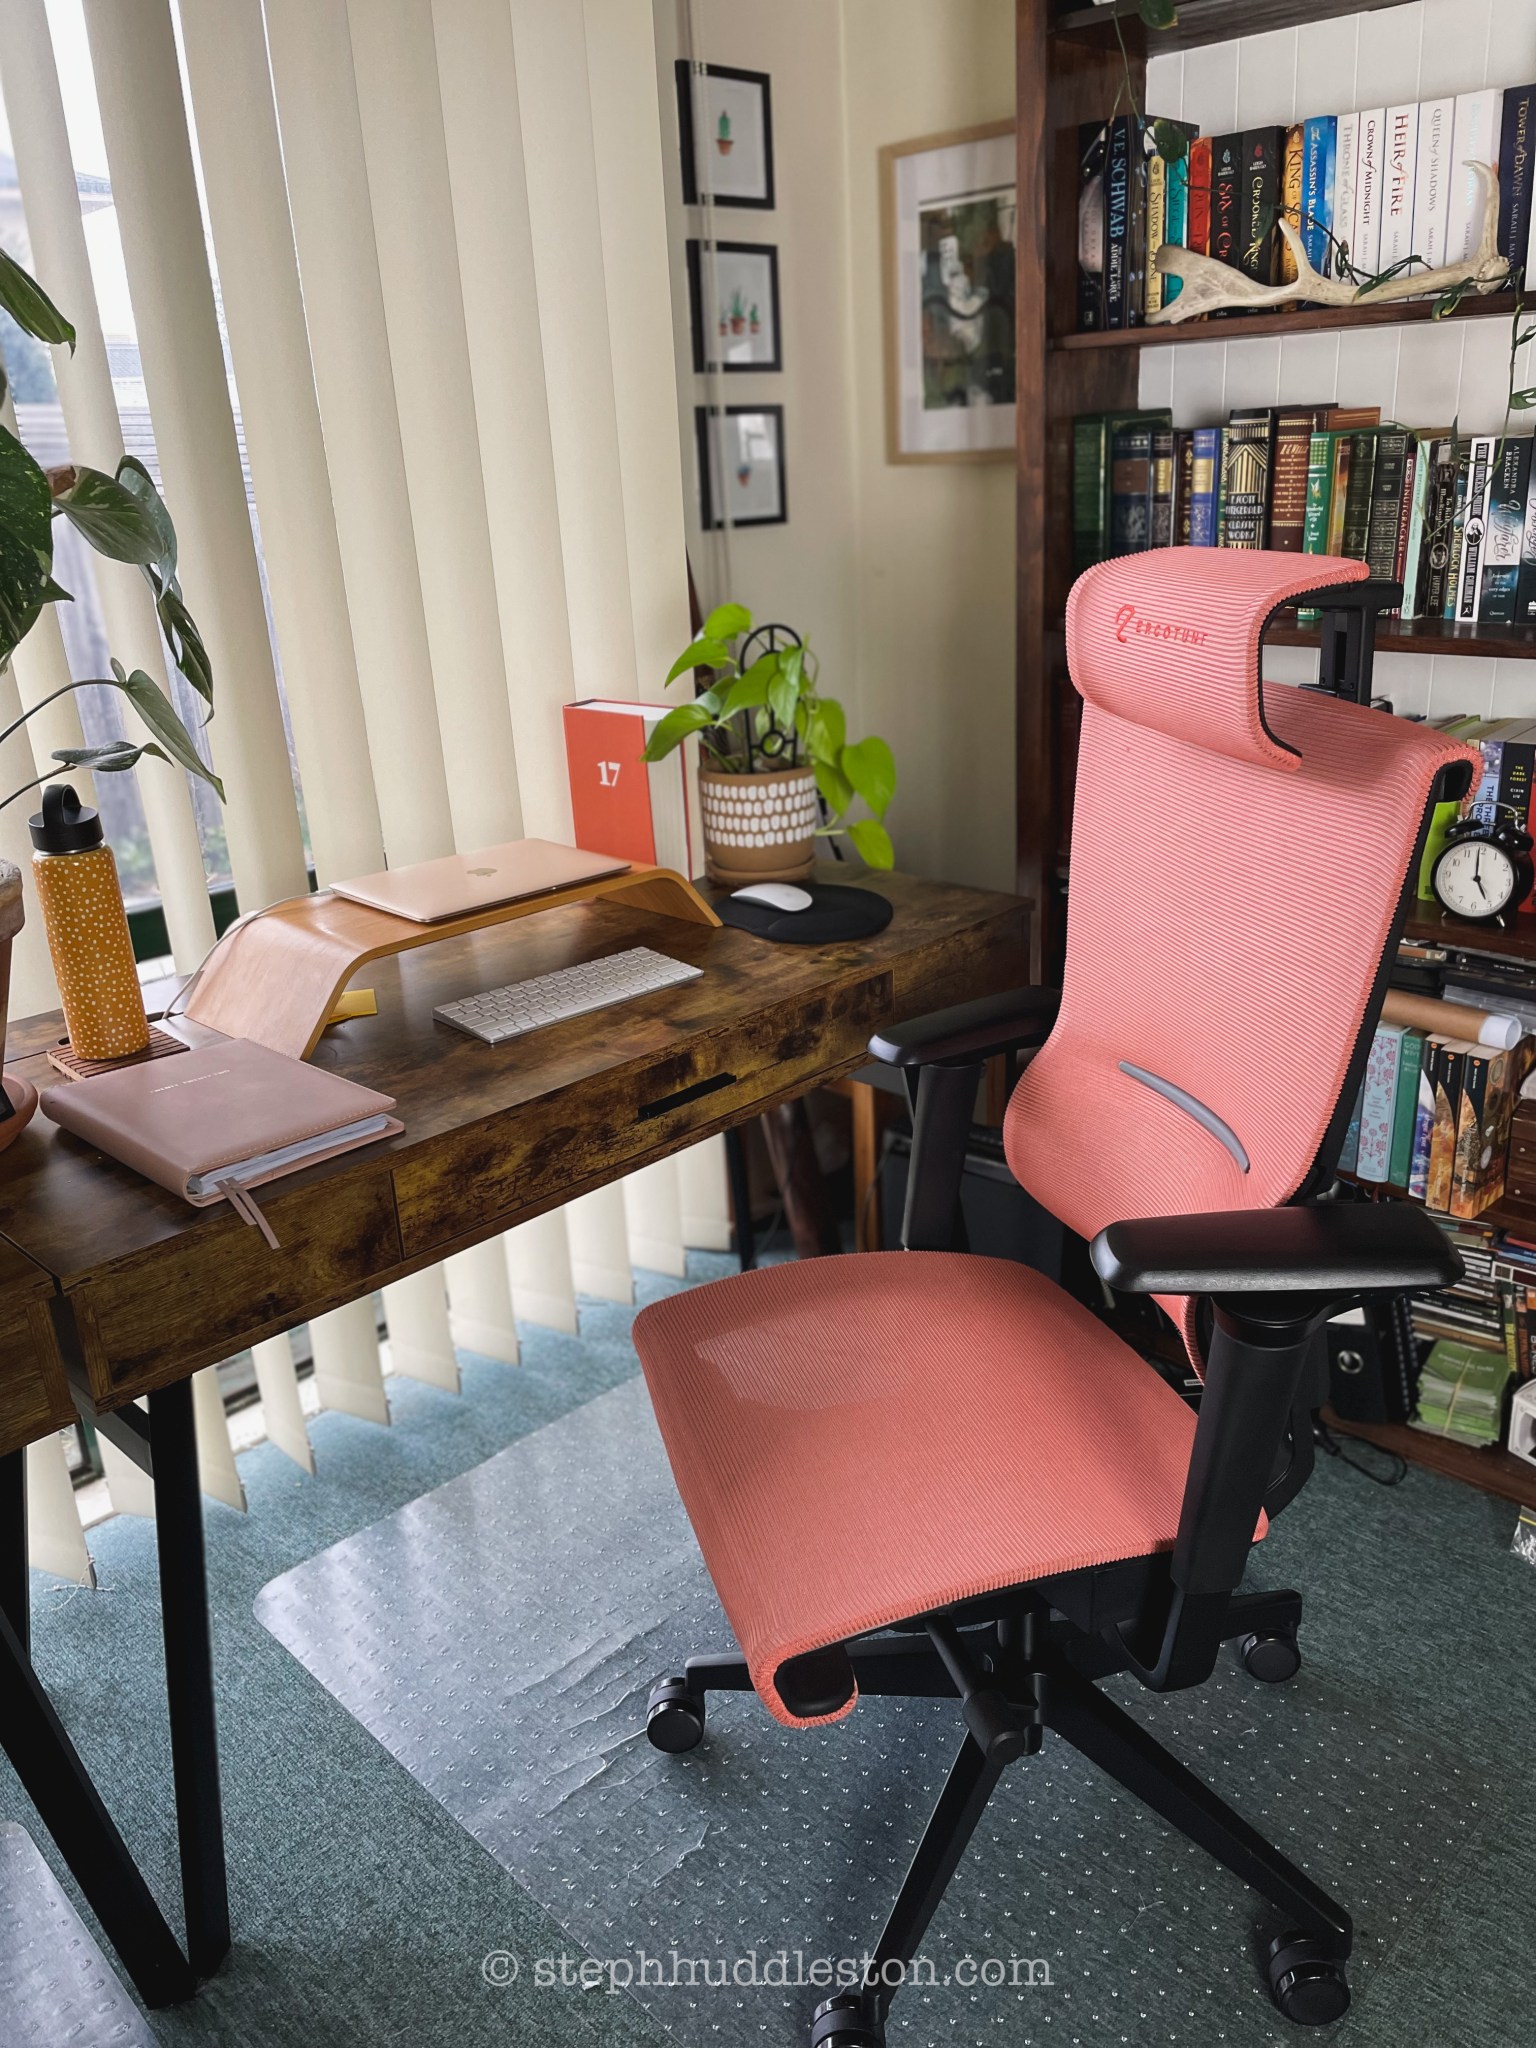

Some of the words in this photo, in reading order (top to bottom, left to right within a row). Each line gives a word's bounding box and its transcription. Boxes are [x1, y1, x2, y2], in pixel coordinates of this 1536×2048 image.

[1393, 113, 1410, 162] HEIR
[1432, 108, 1442, 148] QUEEN
[1515, 97, 1530, 144] TOWER
[1342, 124, 1354, 177] THRONE
[1366, 120, 1376, 159] CROWN
[1287, 148, 1304, 190] KING
[1308, 143, 1319, 196] ASSASSIN'S
[1427, 158, 1439, 212] SHADOWS
[1512, 154, 1527, 197] DAWN
[1110, 158, 1127, 238] SCHWAB
[1362, 171, 1373, 226] MIDNIGHT
[1390, 177, 1406, 217] FIRE
[1150, 192, 1162, 239] SHADOW
[1307, 198, 1317, 232] BLADE
[1510, 203, 1519, 234] SARAH
[1477, 444, 1488, 459] THE
[1503, 451, 1513, 489] BRACKEN
[1509, 445, 1520, 495] ALEXANDRA
[1398, 489, 1411, 552] NUTCRACKER
[1472, 495, 1483, 516] BRIDE
[1228, 520, 1256, 529] CLASSIC
[1228, 531, 1255, 540] WORKS
[1450, 526, 1464, 570] SHERLOCK
[1466, 546, 1478, 574] WILLIAM
[1447, 572, 1459, 607] HOLMES
[1463, 575, 1475, 604] GOLDMAN
[597, 761, 621, 787] 17
[1485, 785, 1494, 802] THE
[1453, 858, 1460, 867] 10
[1464, 849, 1471, 858] 11
[1502, 863, 1509, 872] 2
[1445, 870, 1451, 878] 9
[1505, 878, 1511, 887] 3
[1458, 896, 1464, 904] 7
[1470, 902, 1477, 910] 6
